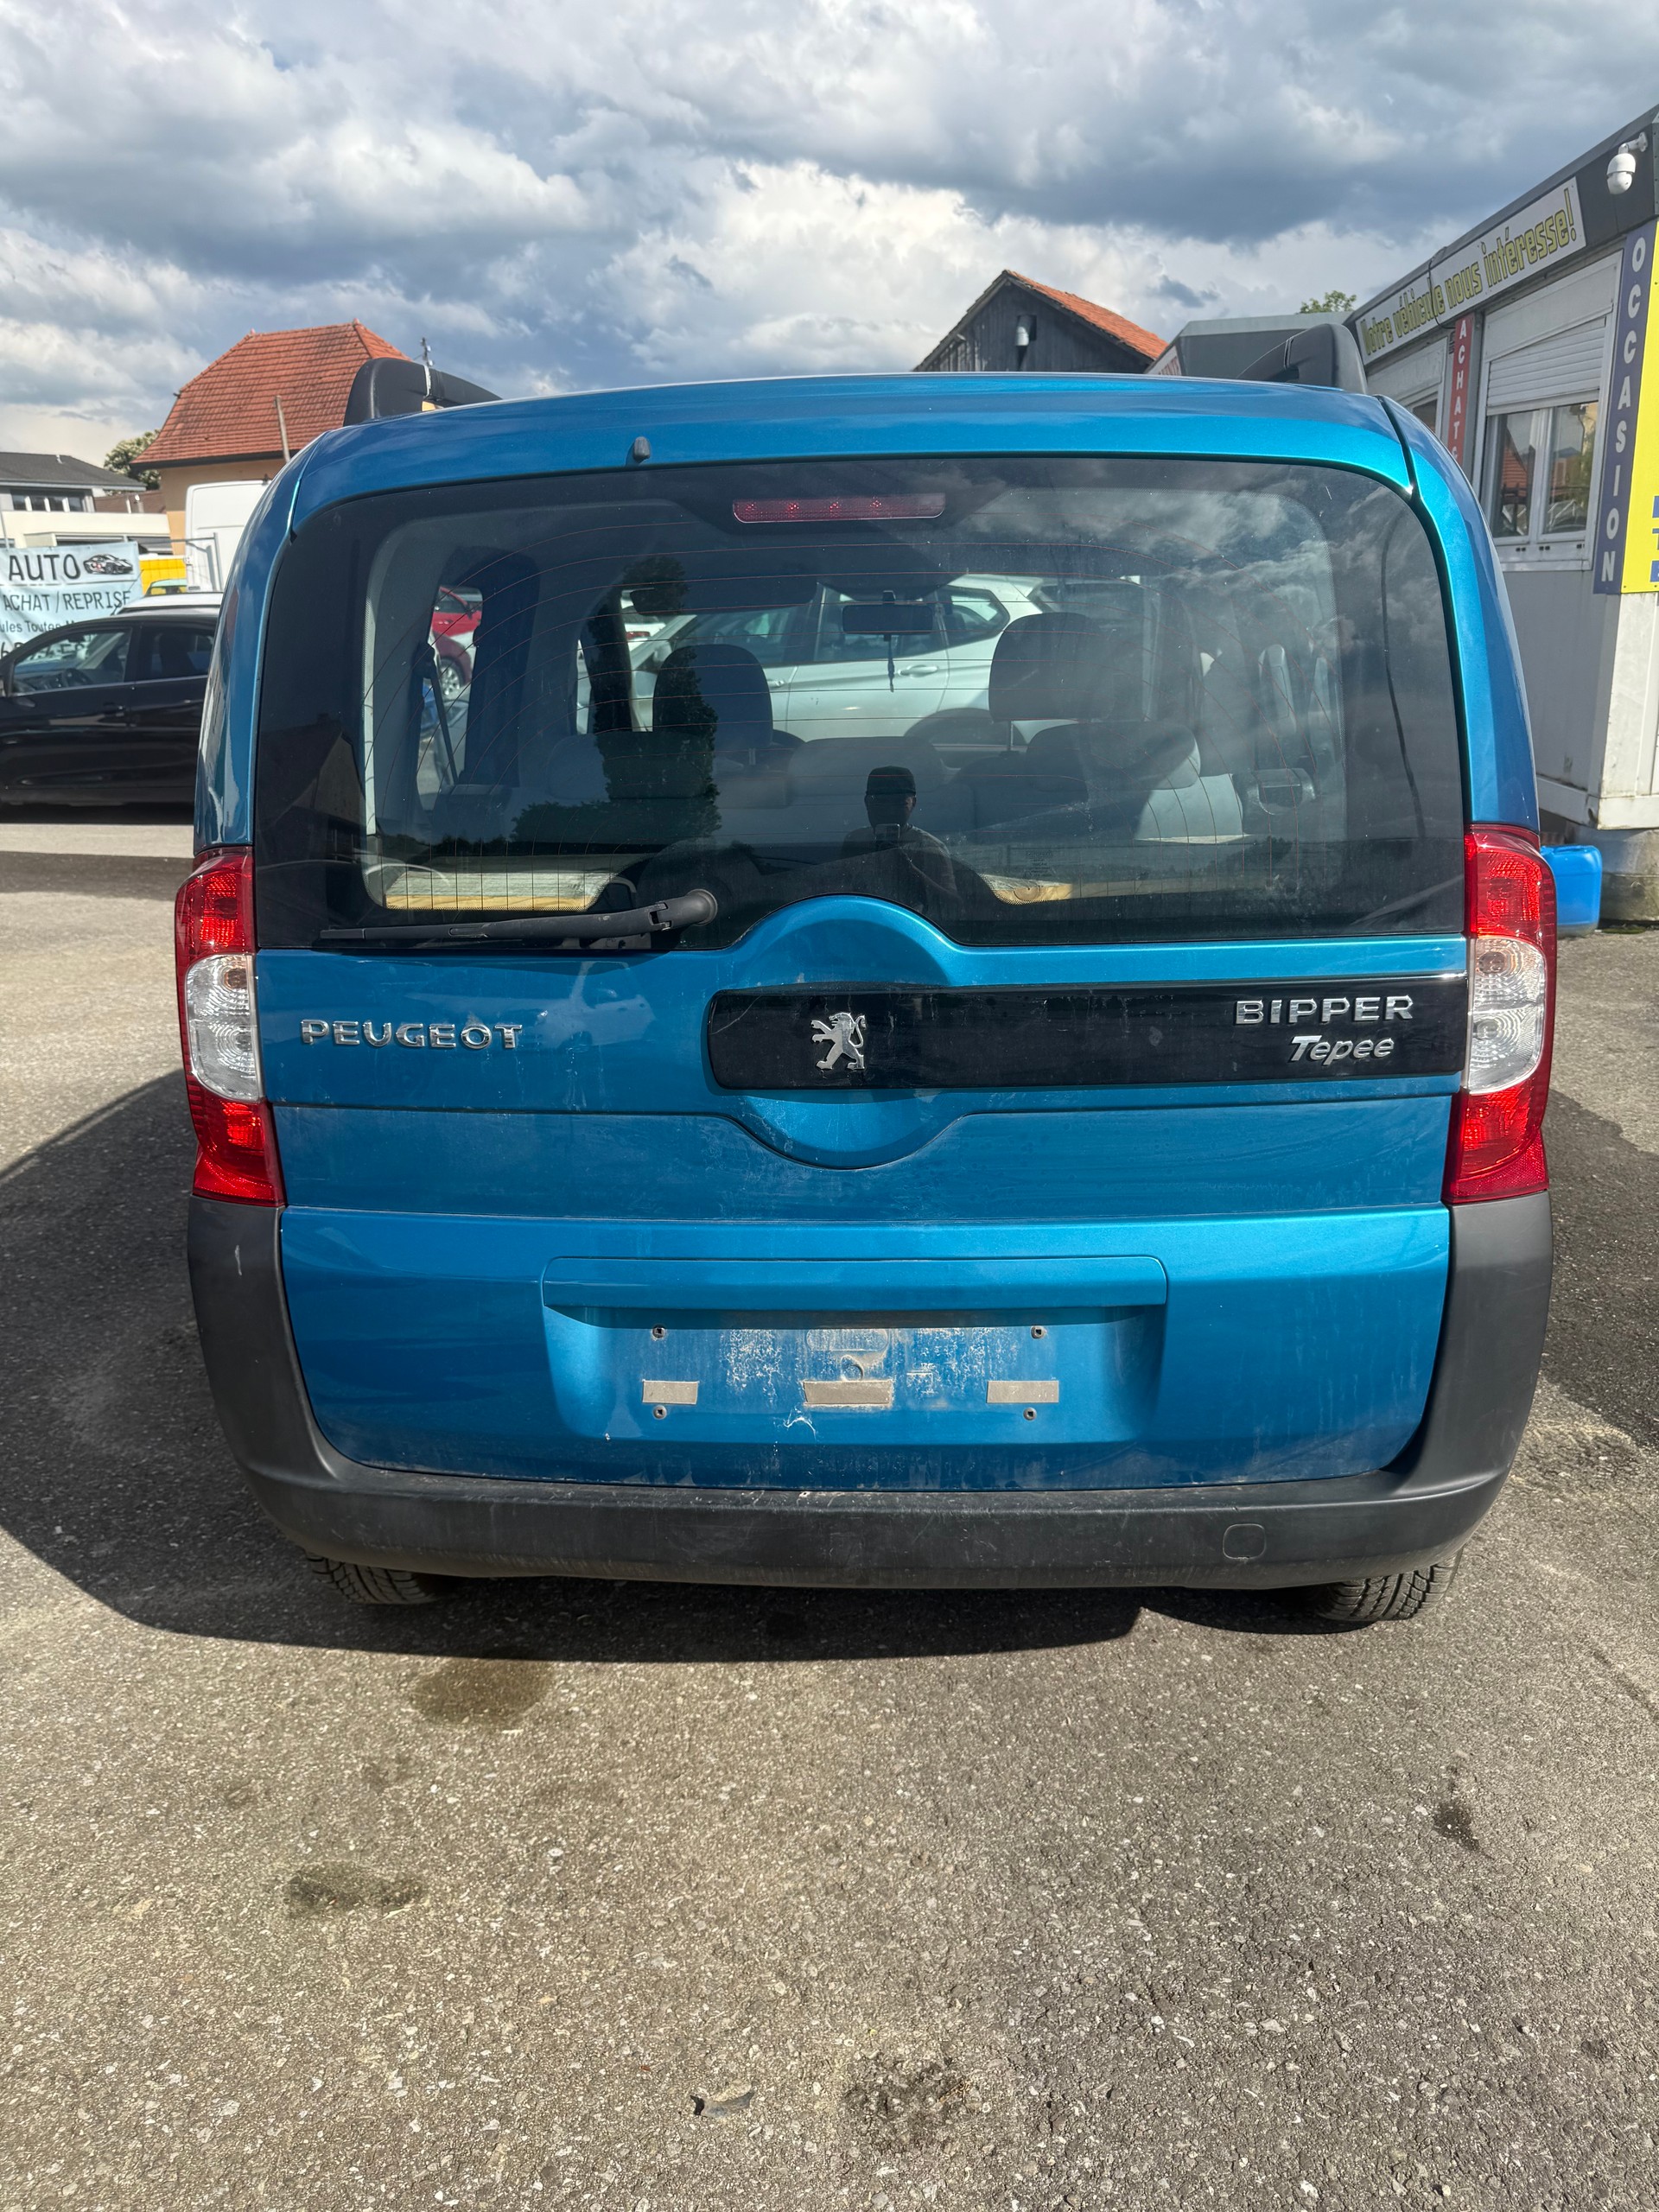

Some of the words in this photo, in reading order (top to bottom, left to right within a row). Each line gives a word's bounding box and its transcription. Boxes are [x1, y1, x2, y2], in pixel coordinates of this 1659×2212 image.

[1393, 276, 1446, 339] véhicule
[1444, 261, 1483, 310] nous
[1483, 188, 1577, 288] intéresse!
[1601, 237, 1646, 582] OCCASION
[9, 554, 81, 581] AUTO
[3, 594, 50, 611] ACHAT
[1236, 995, 1414, 1025] BIPPER
[302, 1019, 522, 1050] PEUGEOT
[1291, 1035, 1395, 1065] Tepee
